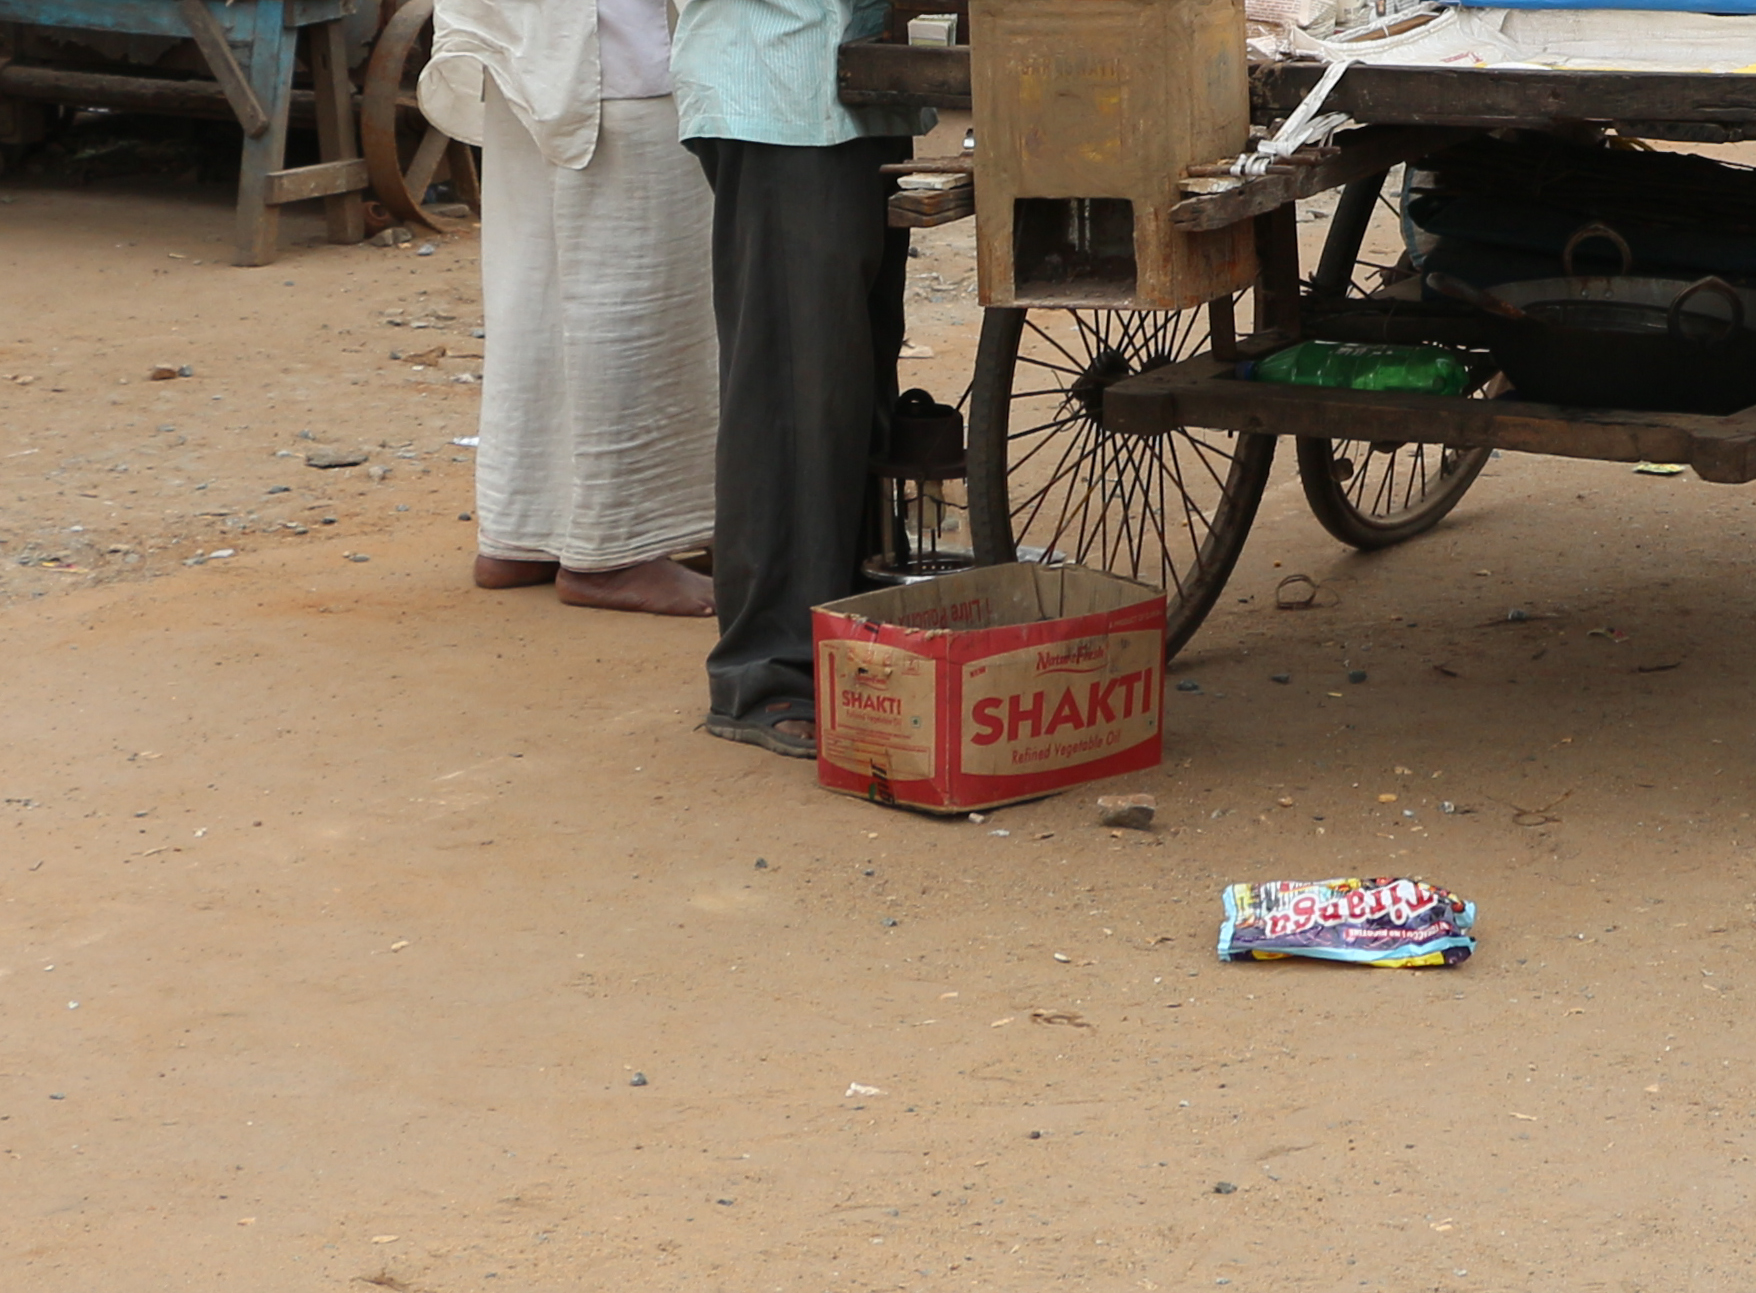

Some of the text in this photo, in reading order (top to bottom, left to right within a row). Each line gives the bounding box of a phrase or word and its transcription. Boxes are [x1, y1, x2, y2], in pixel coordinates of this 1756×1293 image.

[841, 689, 902, 716] SHAKTI
[970, 666, 1154, 746] SHAKTI
[1268, 882, 1435, 937] Tiranga
